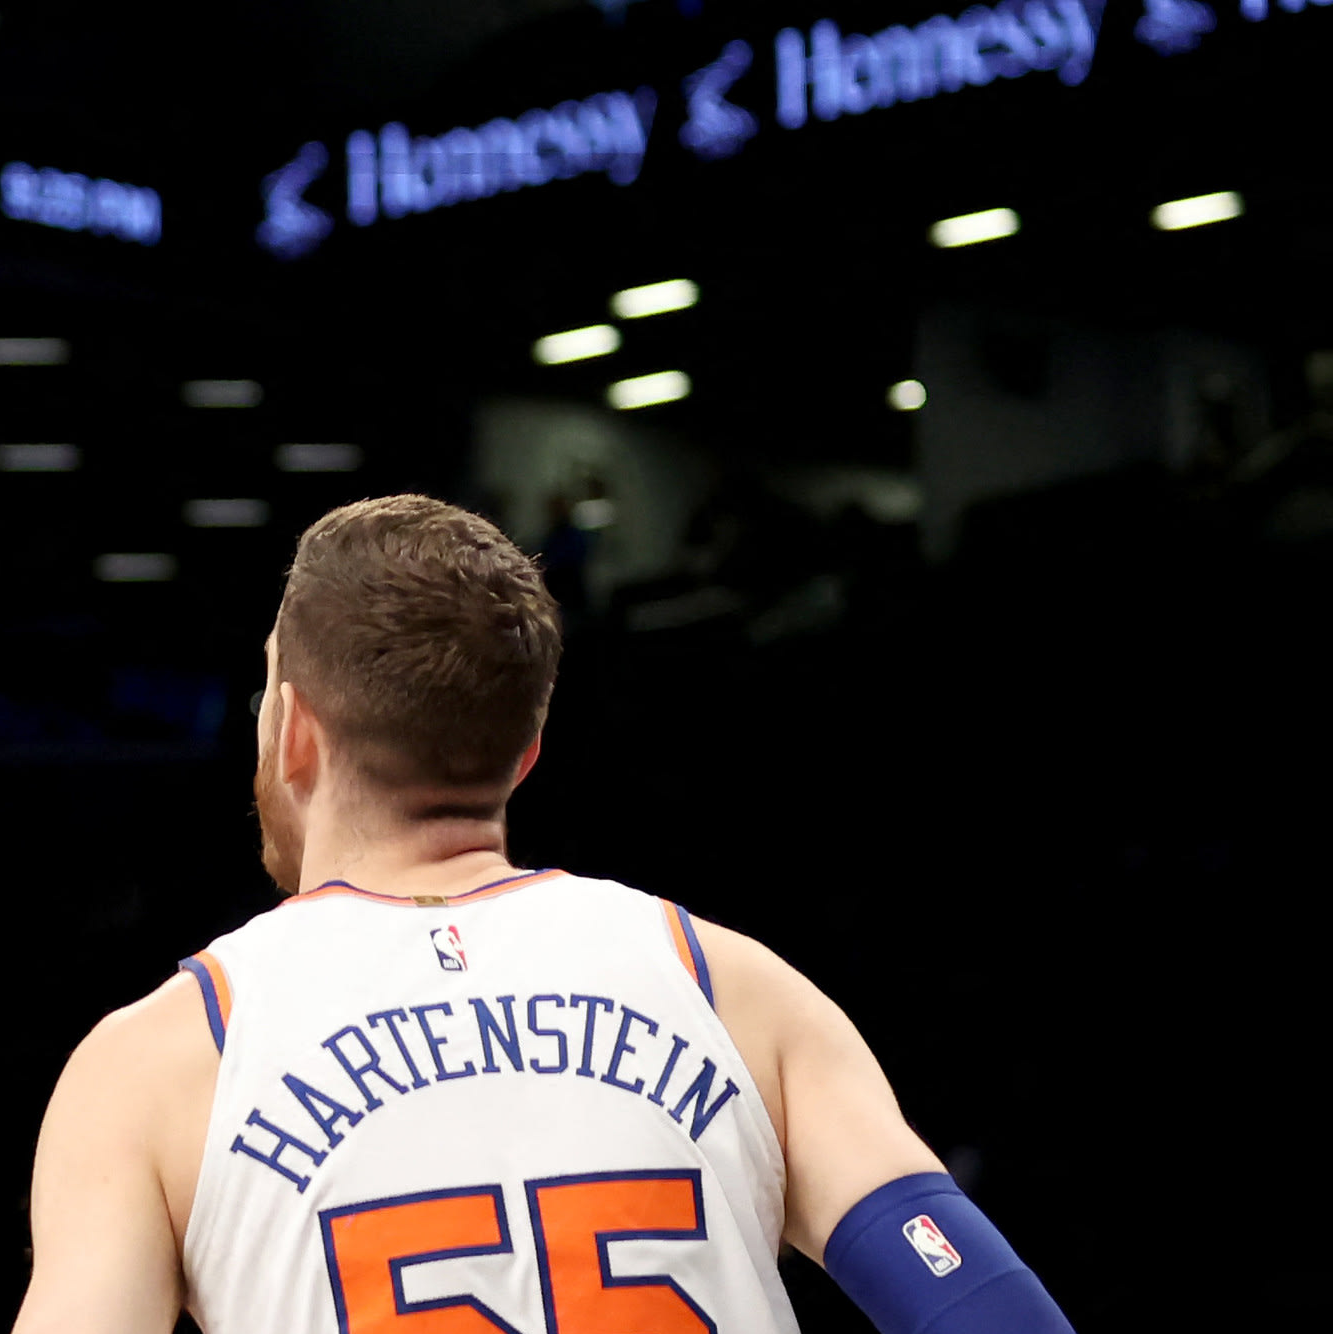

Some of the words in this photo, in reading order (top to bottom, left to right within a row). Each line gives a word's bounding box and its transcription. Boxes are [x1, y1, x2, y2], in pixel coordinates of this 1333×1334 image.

[775, 0, 1105, 128] Hennessy
[347, 86, 657, 225] Hennessy
[230, 993, 740, 1194] HARTENSTEIN
